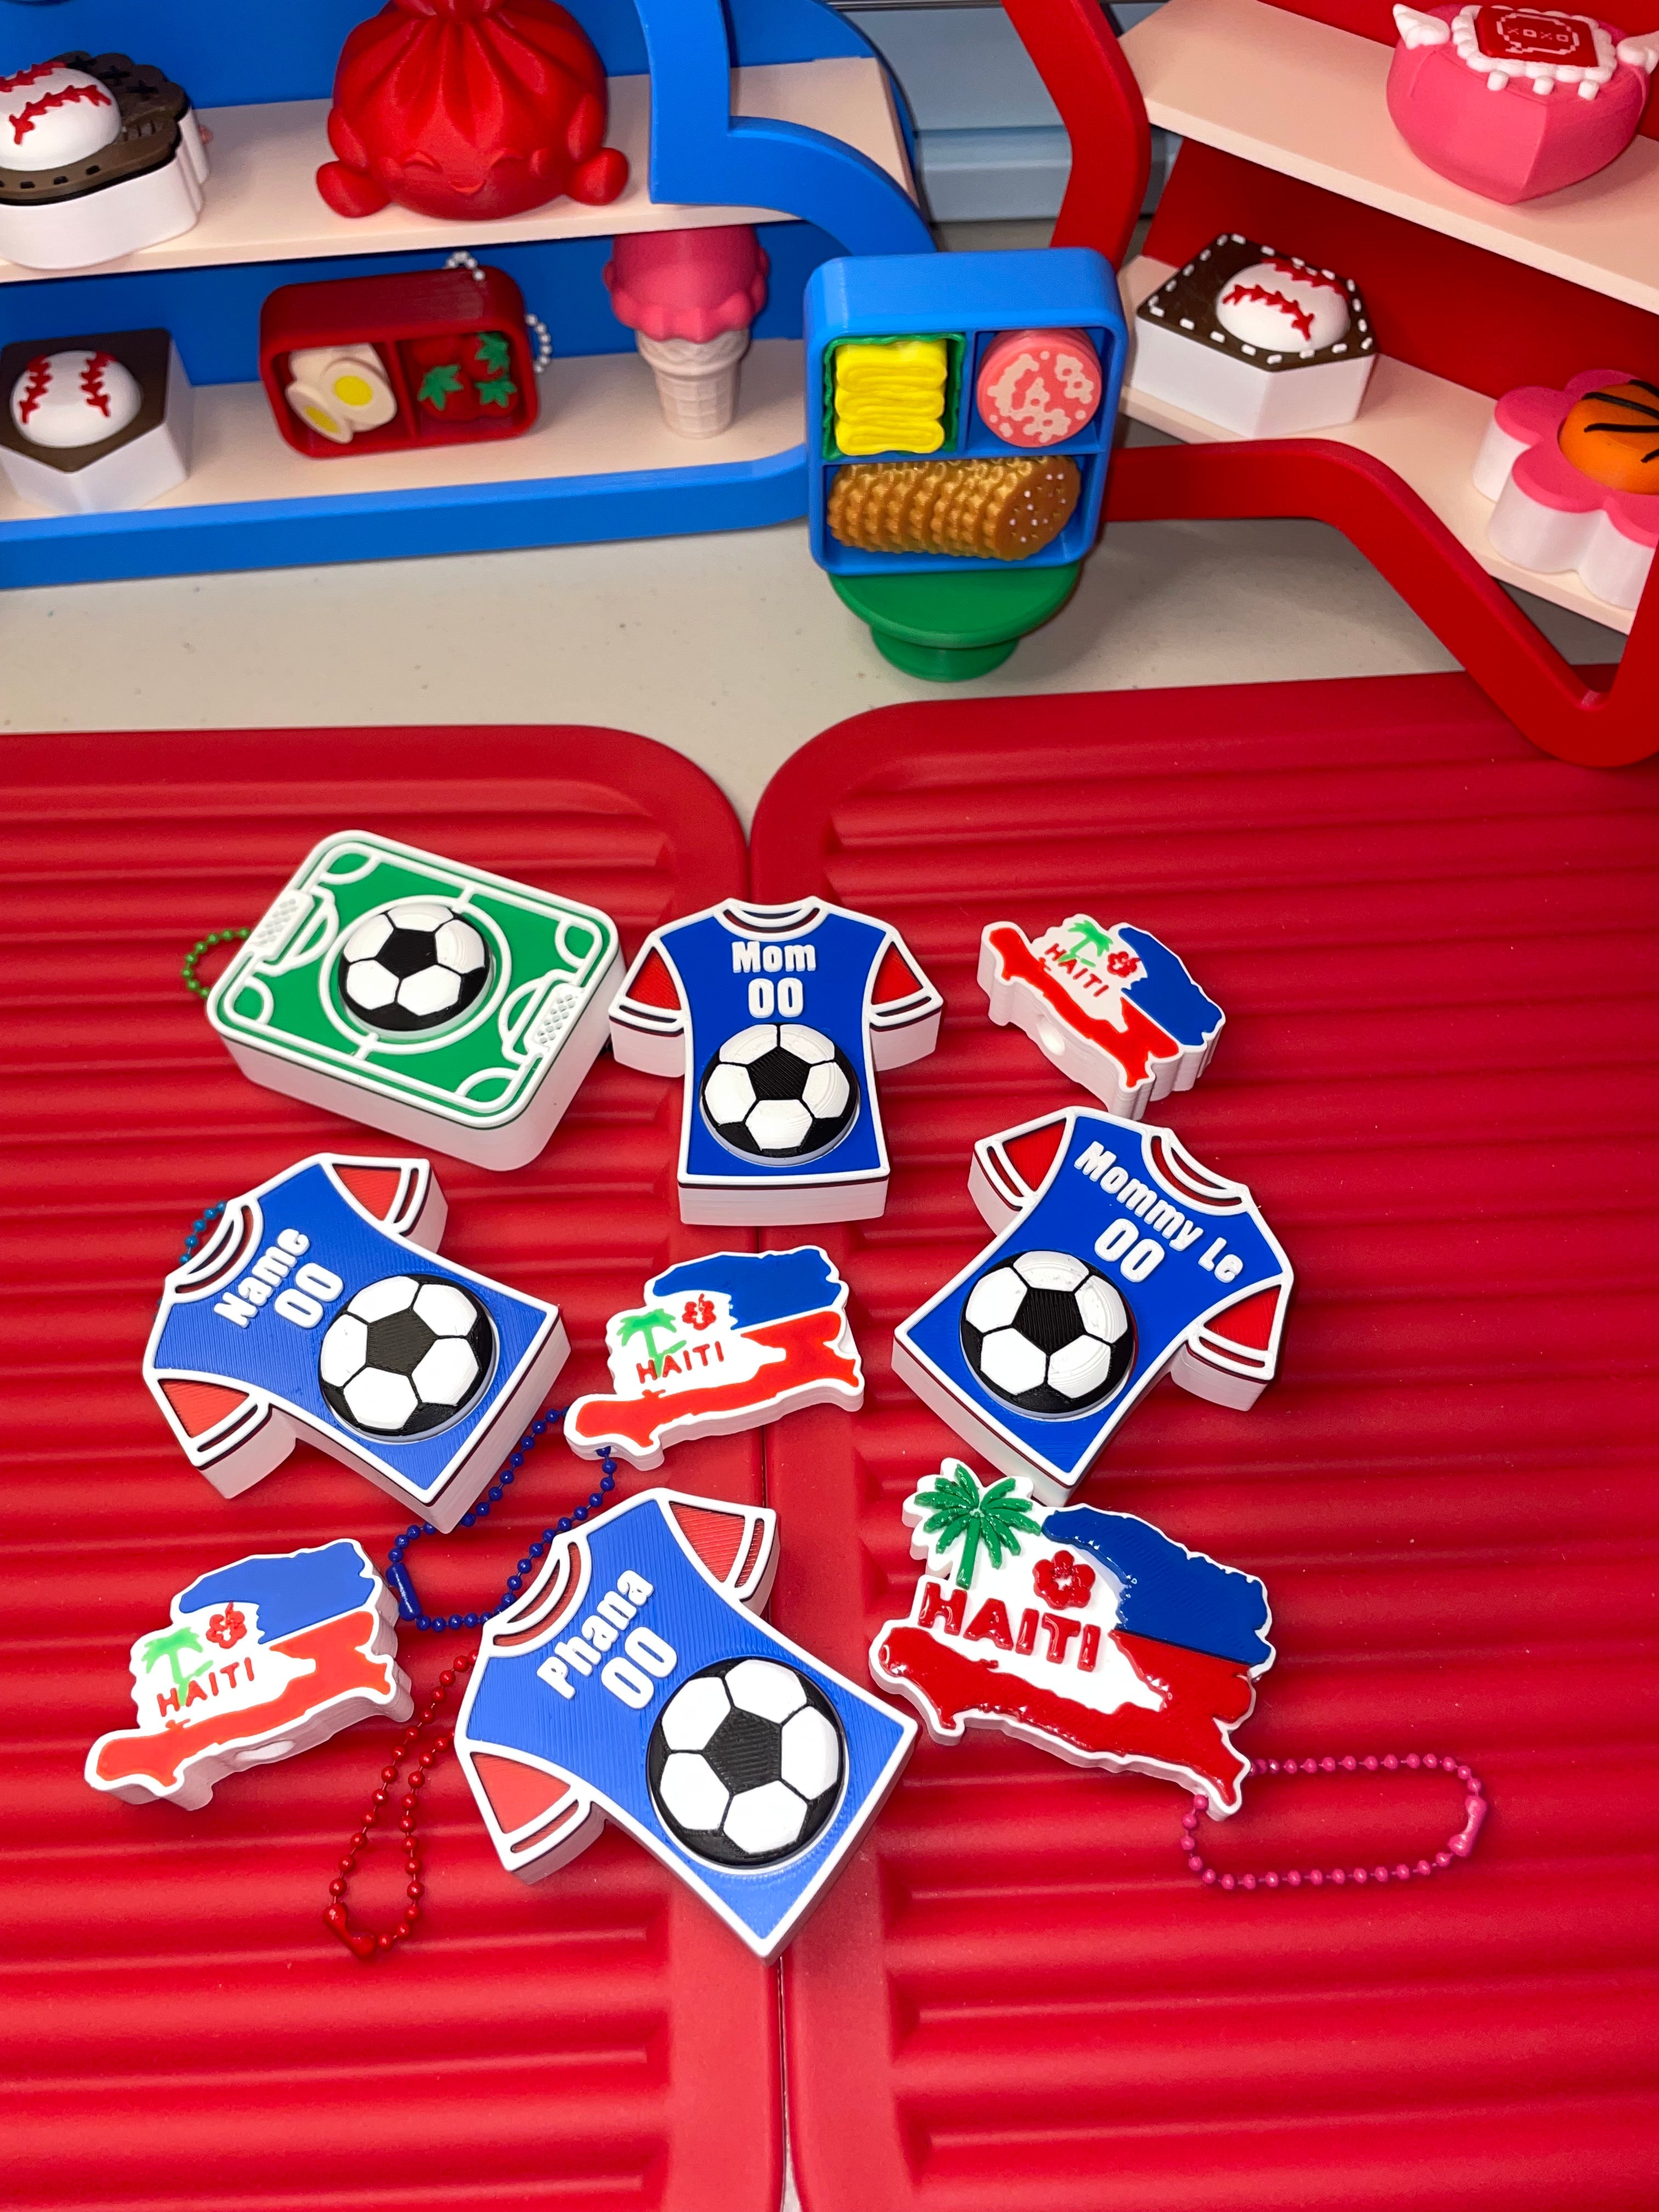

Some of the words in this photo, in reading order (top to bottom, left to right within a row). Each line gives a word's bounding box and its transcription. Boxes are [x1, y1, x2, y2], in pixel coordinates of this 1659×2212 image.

[731, 940, 817, 973] Mom
[1044, 943, 1110, 997] HAITI
[1073, 1141, 1204, 1252] Mommy
[1198, 1237, 1244, 1283] Le
[213, 1228, 311, 1329] Name
[635, 1340, 725, 1384] HAITI
[536, 1570, 654, 1700] Phana
[917, 1581, 1102, 1673] HAITI
[156, 1656, 255, 1718] HAITI
